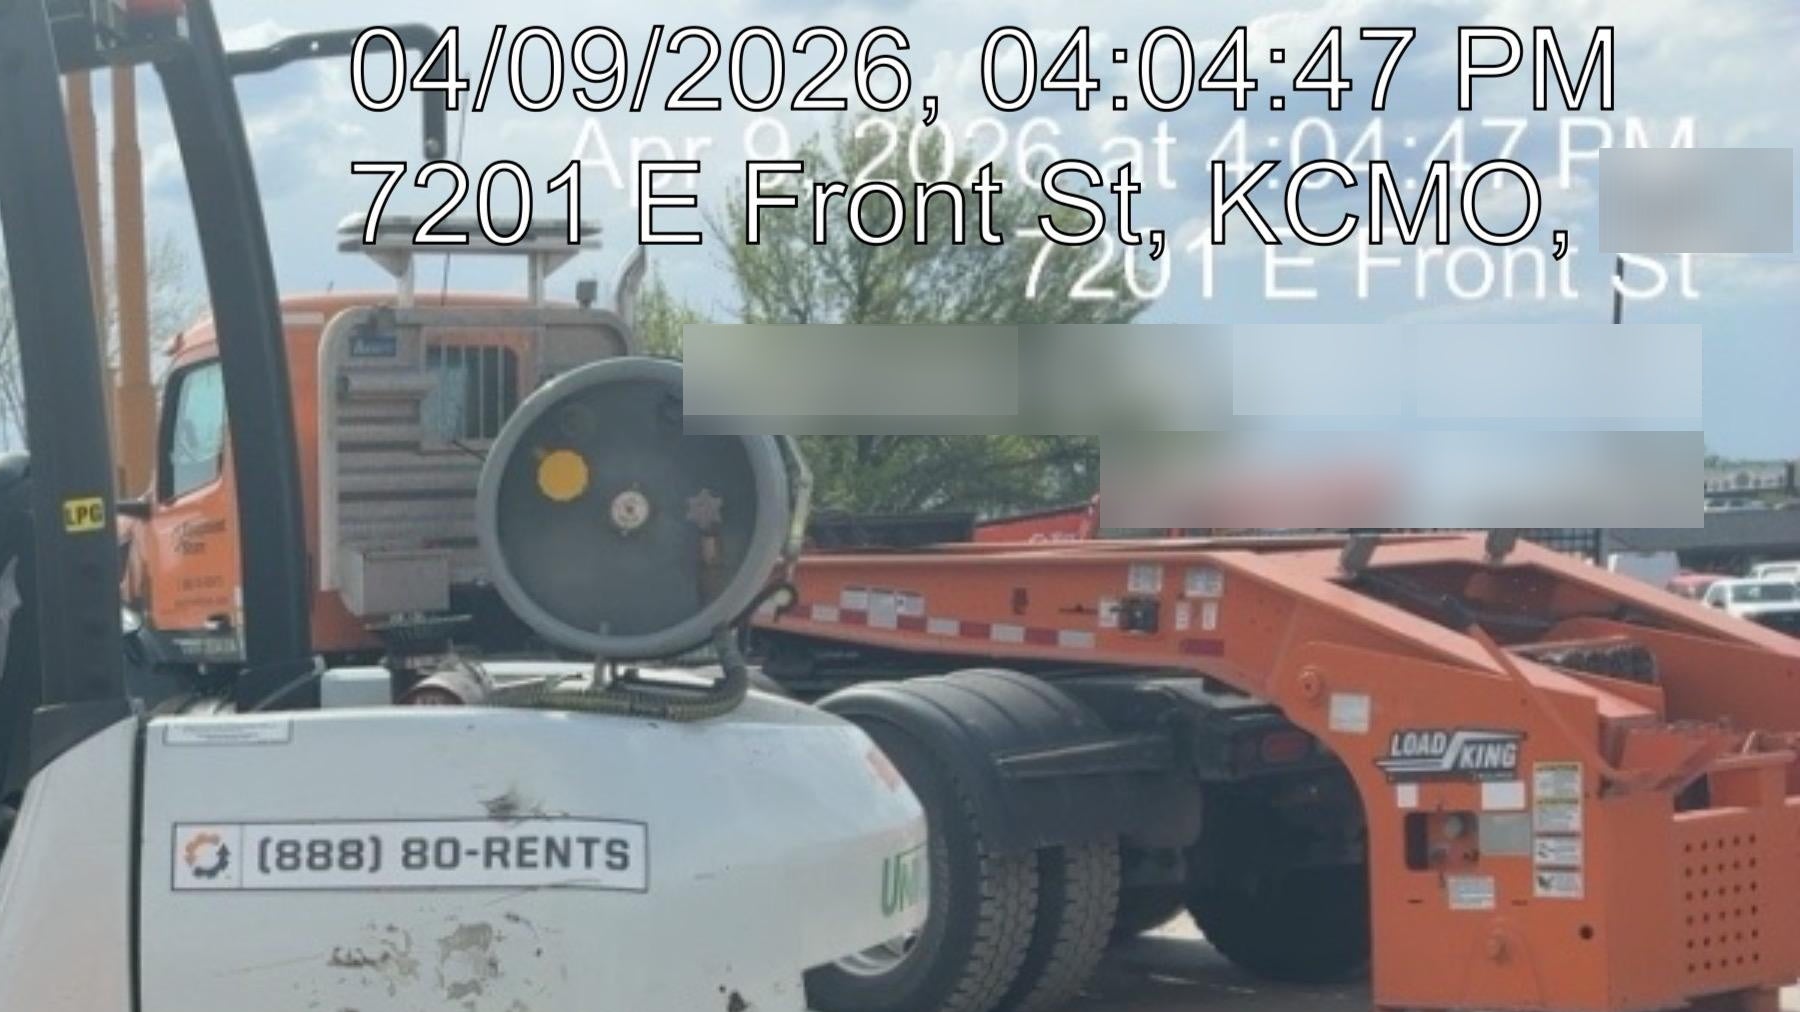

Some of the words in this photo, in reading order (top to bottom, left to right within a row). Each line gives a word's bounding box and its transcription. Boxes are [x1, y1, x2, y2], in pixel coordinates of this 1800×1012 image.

[64, 503, 103, 526] LPG
[1390, 731, 1445, 757] LOAD
[1459, 742, 1518, 769] KING
[256, 835, 383, 875] (888)
[400, 834, 632, 872] 80-RENTS
